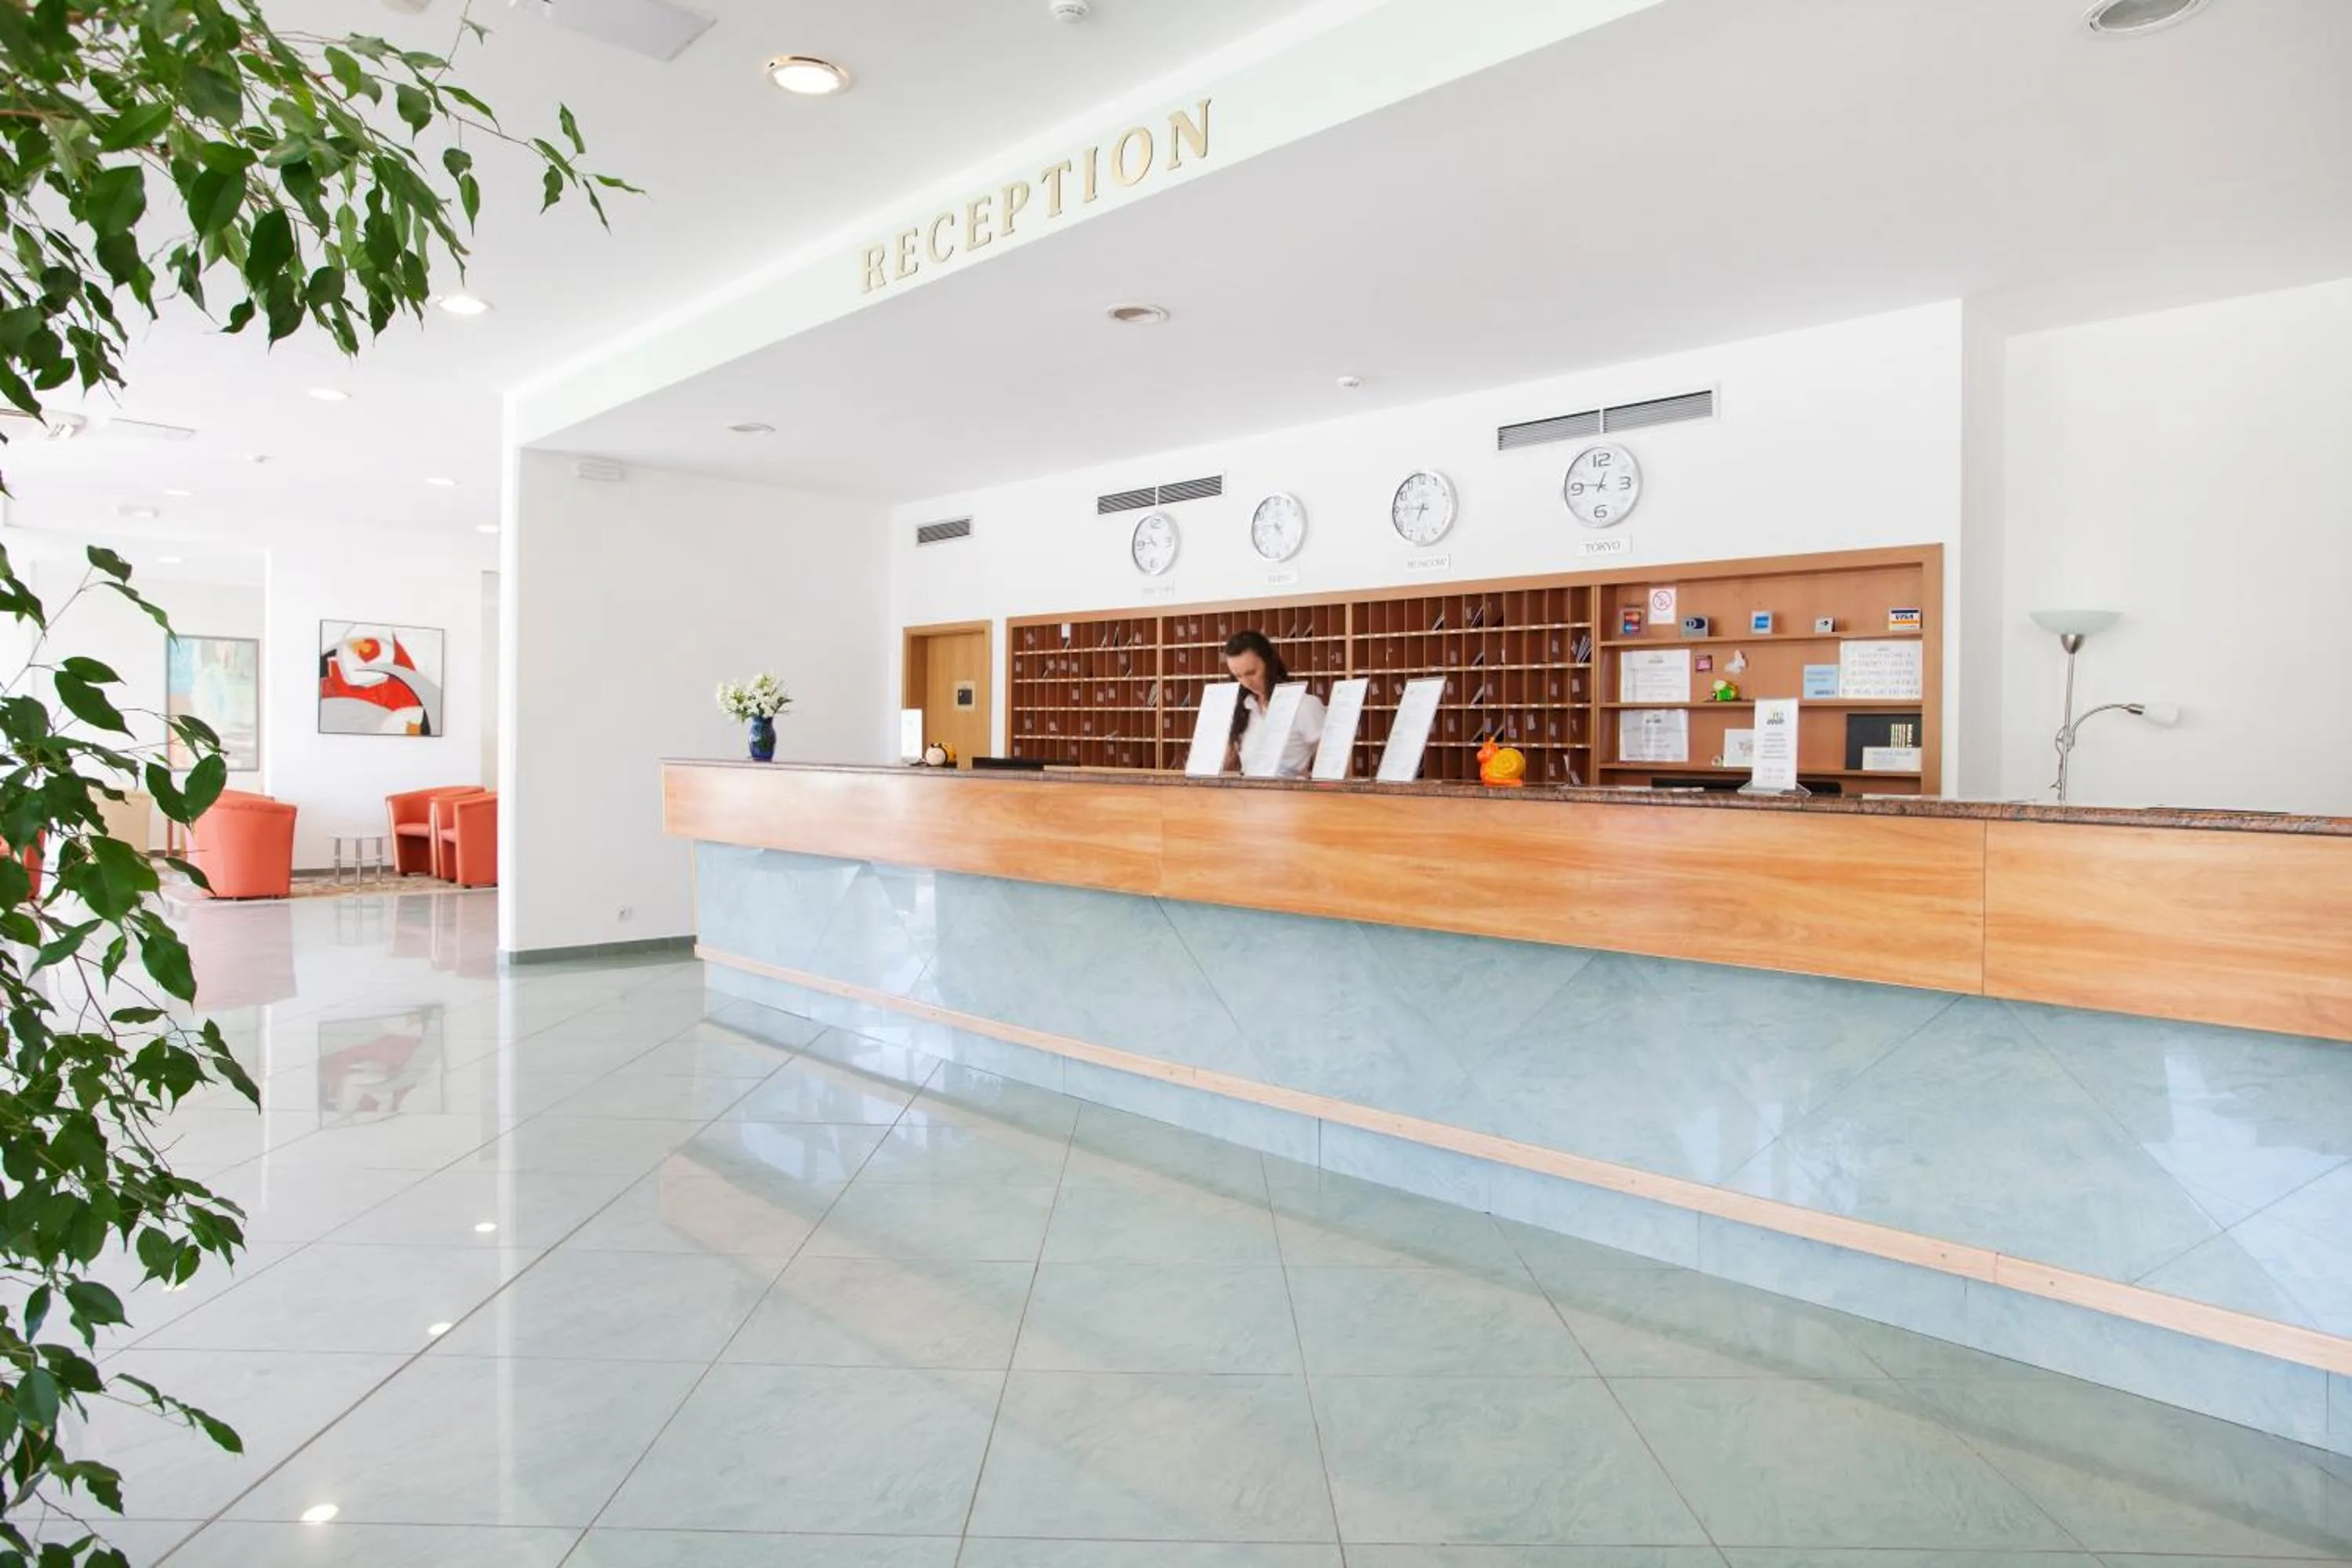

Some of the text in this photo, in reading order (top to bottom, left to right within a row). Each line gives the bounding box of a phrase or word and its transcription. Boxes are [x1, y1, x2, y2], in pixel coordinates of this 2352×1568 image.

[862, 98, 1212, 293] RECEPTION
[1592, 452, 1611, 467] 12
[1570, 482, 1584, 496] 9
[1618, 476, 1632, 491] 3
[1593, 504, 1608, 518] 6
[1584, 539, 1621, 553] TOKYO
